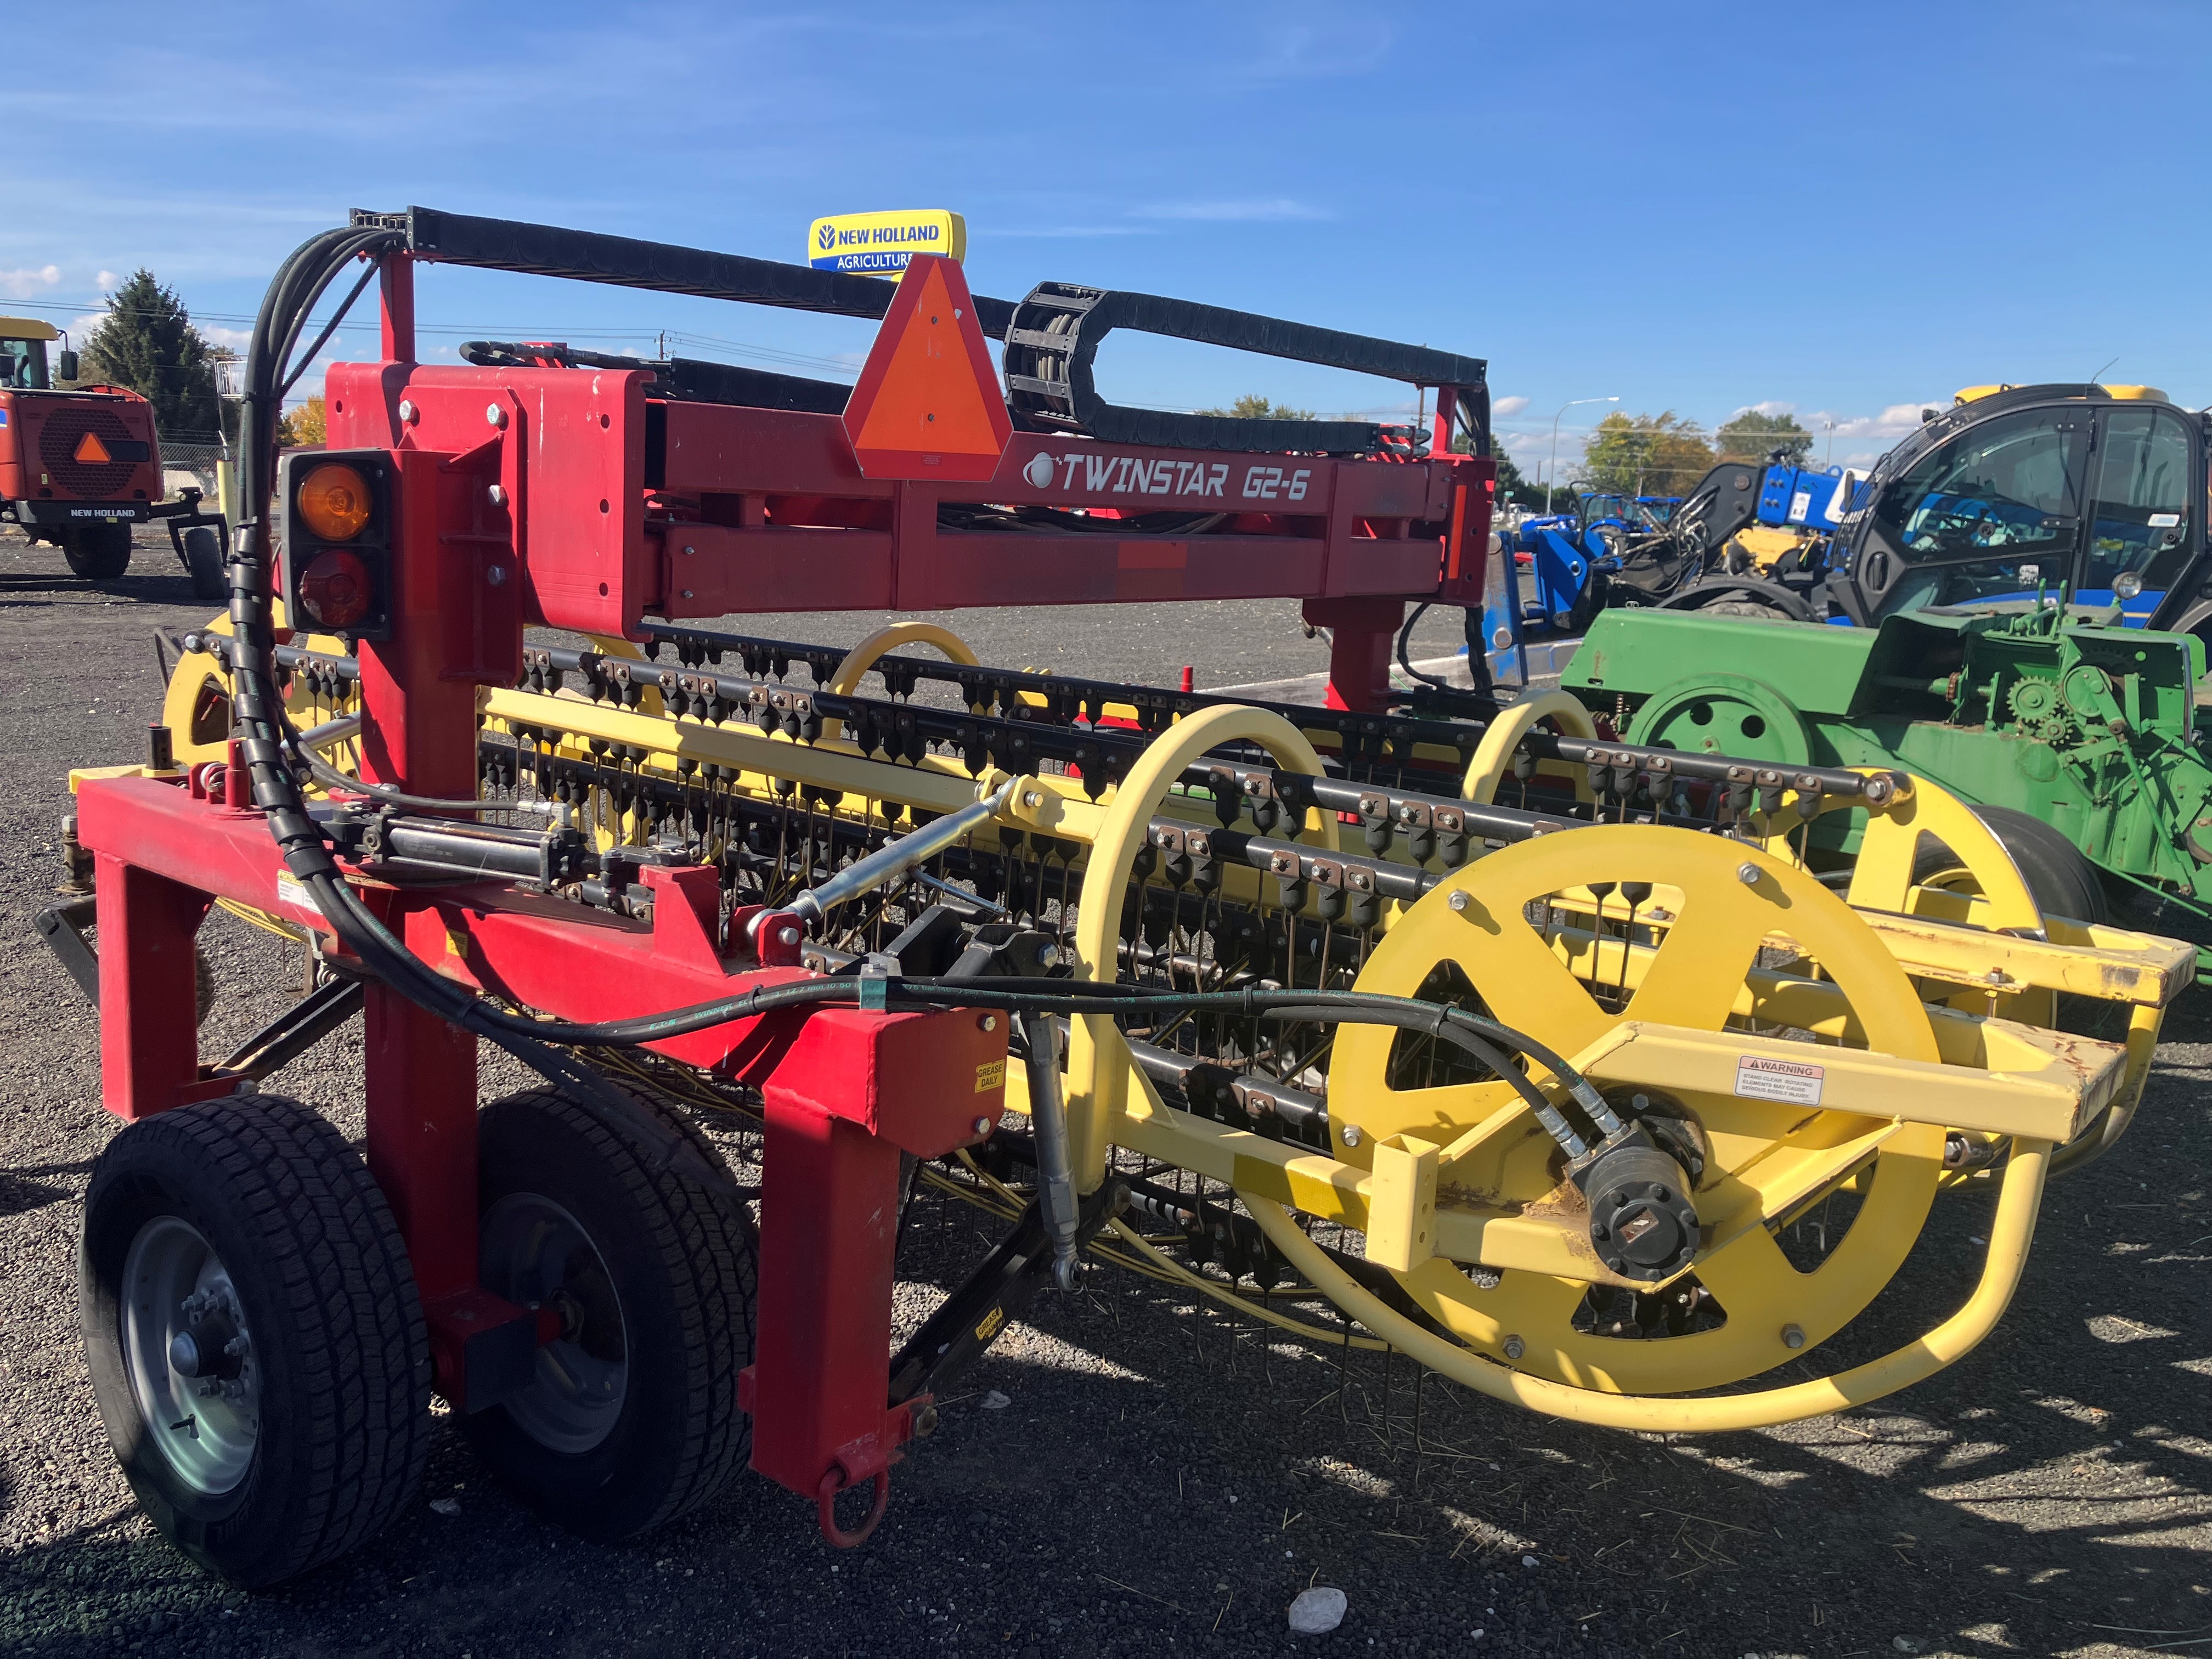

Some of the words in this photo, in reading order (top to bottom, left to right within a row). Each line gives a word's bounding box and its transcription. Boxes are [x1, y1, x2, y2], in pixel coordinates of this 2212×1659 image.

[839, 229, 870, 245] NEW
[873, 225, 939, 244] HOLLAND
[1063, 453, 1229, 498] TWINSTAR
[1242, 466, 1312, 500] G2-6
[978, 1064, 1002, 1077] GREASE
[1761, 1060, 1813, 1076] WARNING
[981, 1075, 997, 1087] DAILY
[1742, 1079, 1772, 1087] ELEMENTS
[1785, 1079, 1813, 1088] ROTATING
[978, 1310, 999, 1335] GREAS
